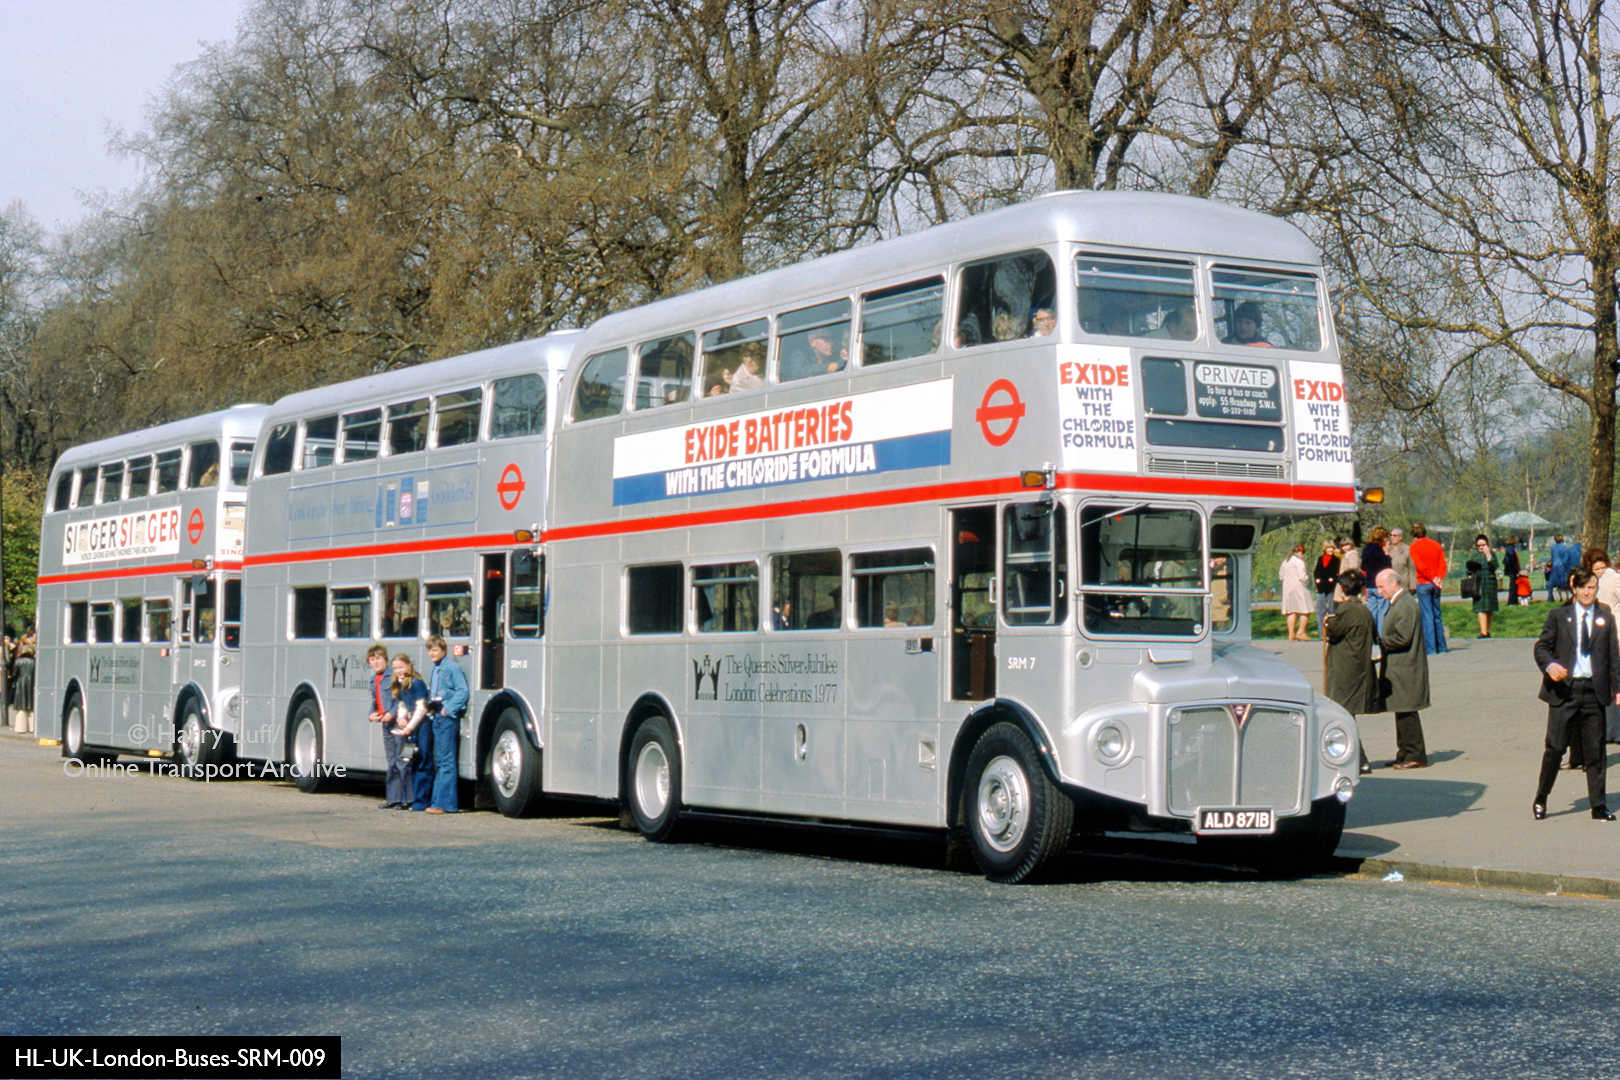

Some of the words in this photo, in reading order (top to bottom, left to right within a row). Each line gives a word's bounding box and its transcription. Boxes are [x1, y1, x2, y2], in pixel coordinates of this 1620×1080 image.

[1060, 361, 1129, 387] EXIDE
[1201, 366, 1269, 386] PRIVATE
[1076, 387, 1113, 401] WITH
[1251, 390, 1268, 399] coach
[1082, 403, 1112, 417] THE
[1307, 402, 1340, 417] WITH
[685, 419, 740, 464] EXIDE
[745, 400, 853, 455] BATTERIES
[1063, 418, 1135, 434] CHLORIDE
[1313, 417, 1340, 432] THE
[1063, 433, 1135, 450] FORMULA
[1297, 432, 1352, 448] CHLORID
[665, 467, 698, 496] WITH
[700, 462, 725, 491] THE
[726, 452, 798, 488] CHLORIDE
[799, 443, 876, 480] FORMULA
[725, 653, 743, 674] The
[743, 653, 777, 678] Queen's
[777, 653, 806, 674] Silver
[804, 652, 839, 674] Jubilee
[1007, 657, 1027, 670] SRM
[1029, 656, 1036, 670] 7
[725, 682, 757, 702] London
[758, 682, 812, 703] Celebrations
[814, 683, 838, 704] 1977
[1204, 811, 1234, 829] ALD
